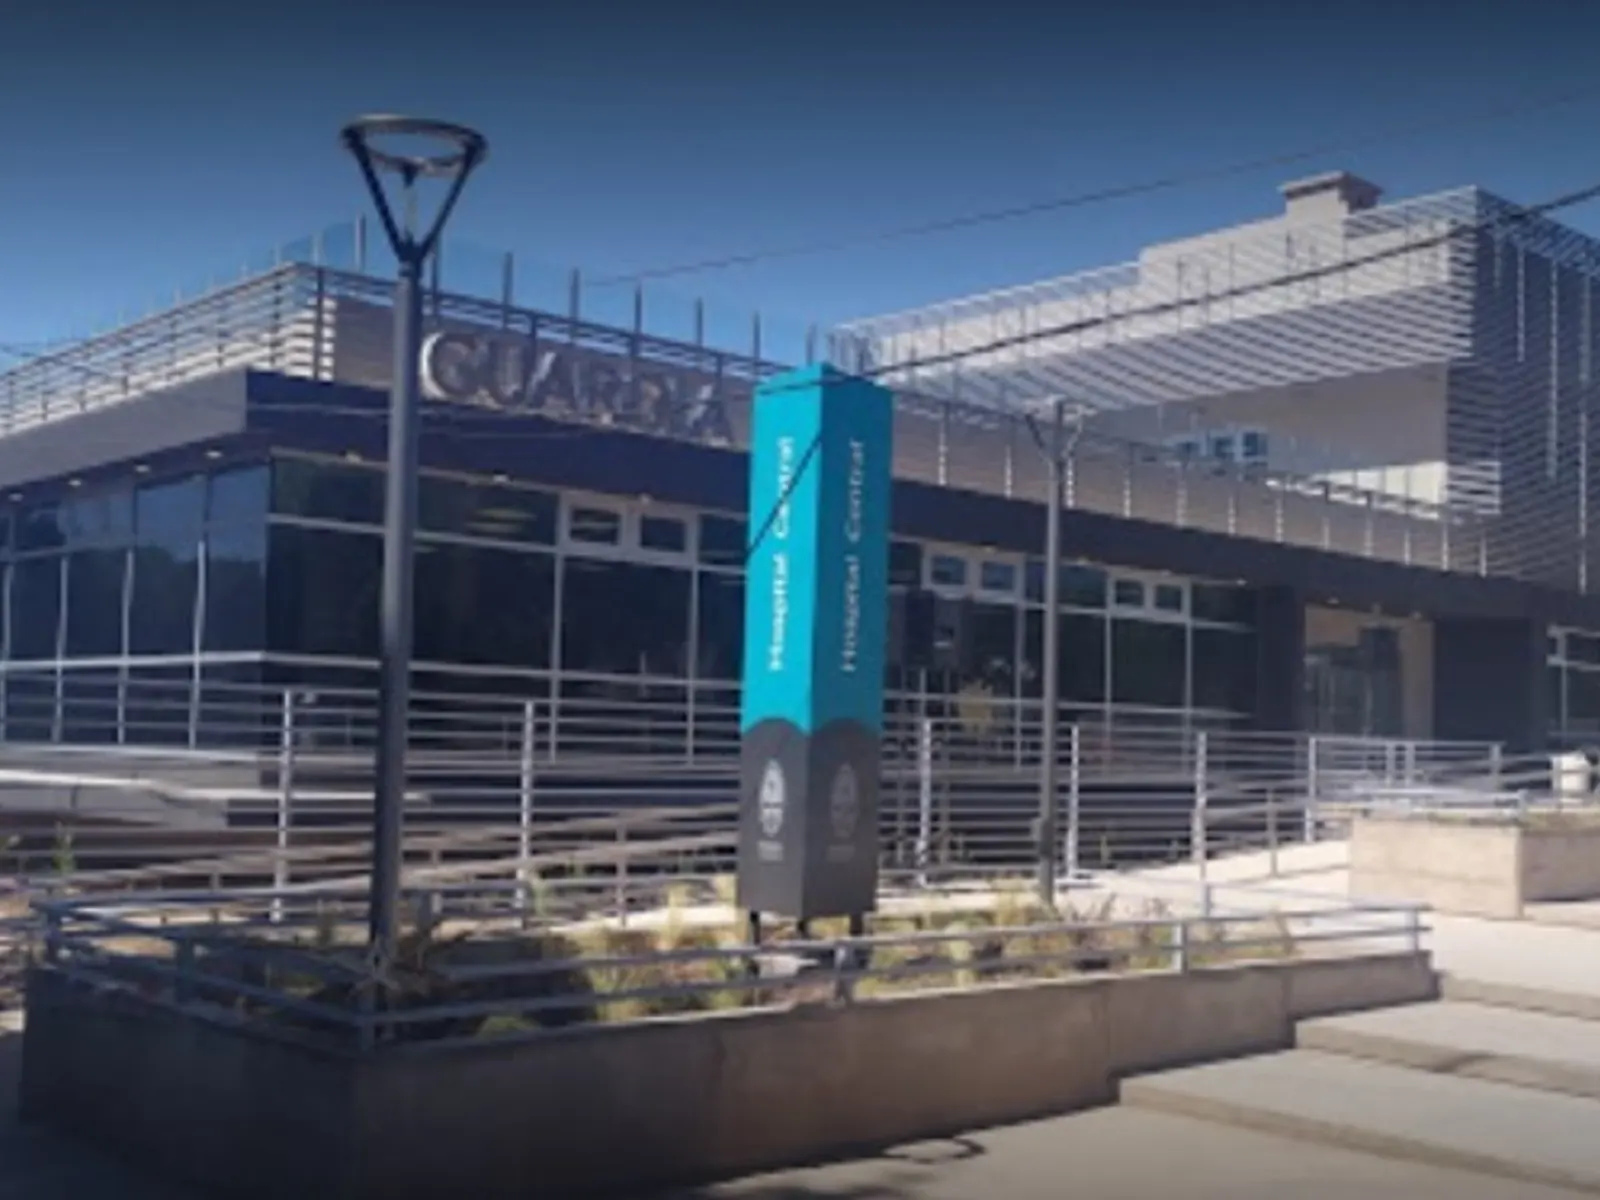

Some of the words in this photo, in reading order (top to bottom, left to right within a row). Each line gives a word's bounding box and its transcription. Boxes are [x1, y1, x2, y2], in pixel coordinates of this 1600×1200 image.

[772, 436, 795, 540] Central
[844, 437, 865, 544] Central
[768, 553, 788, 672] Hospital
[840, 554, 861, 673] Hospital
